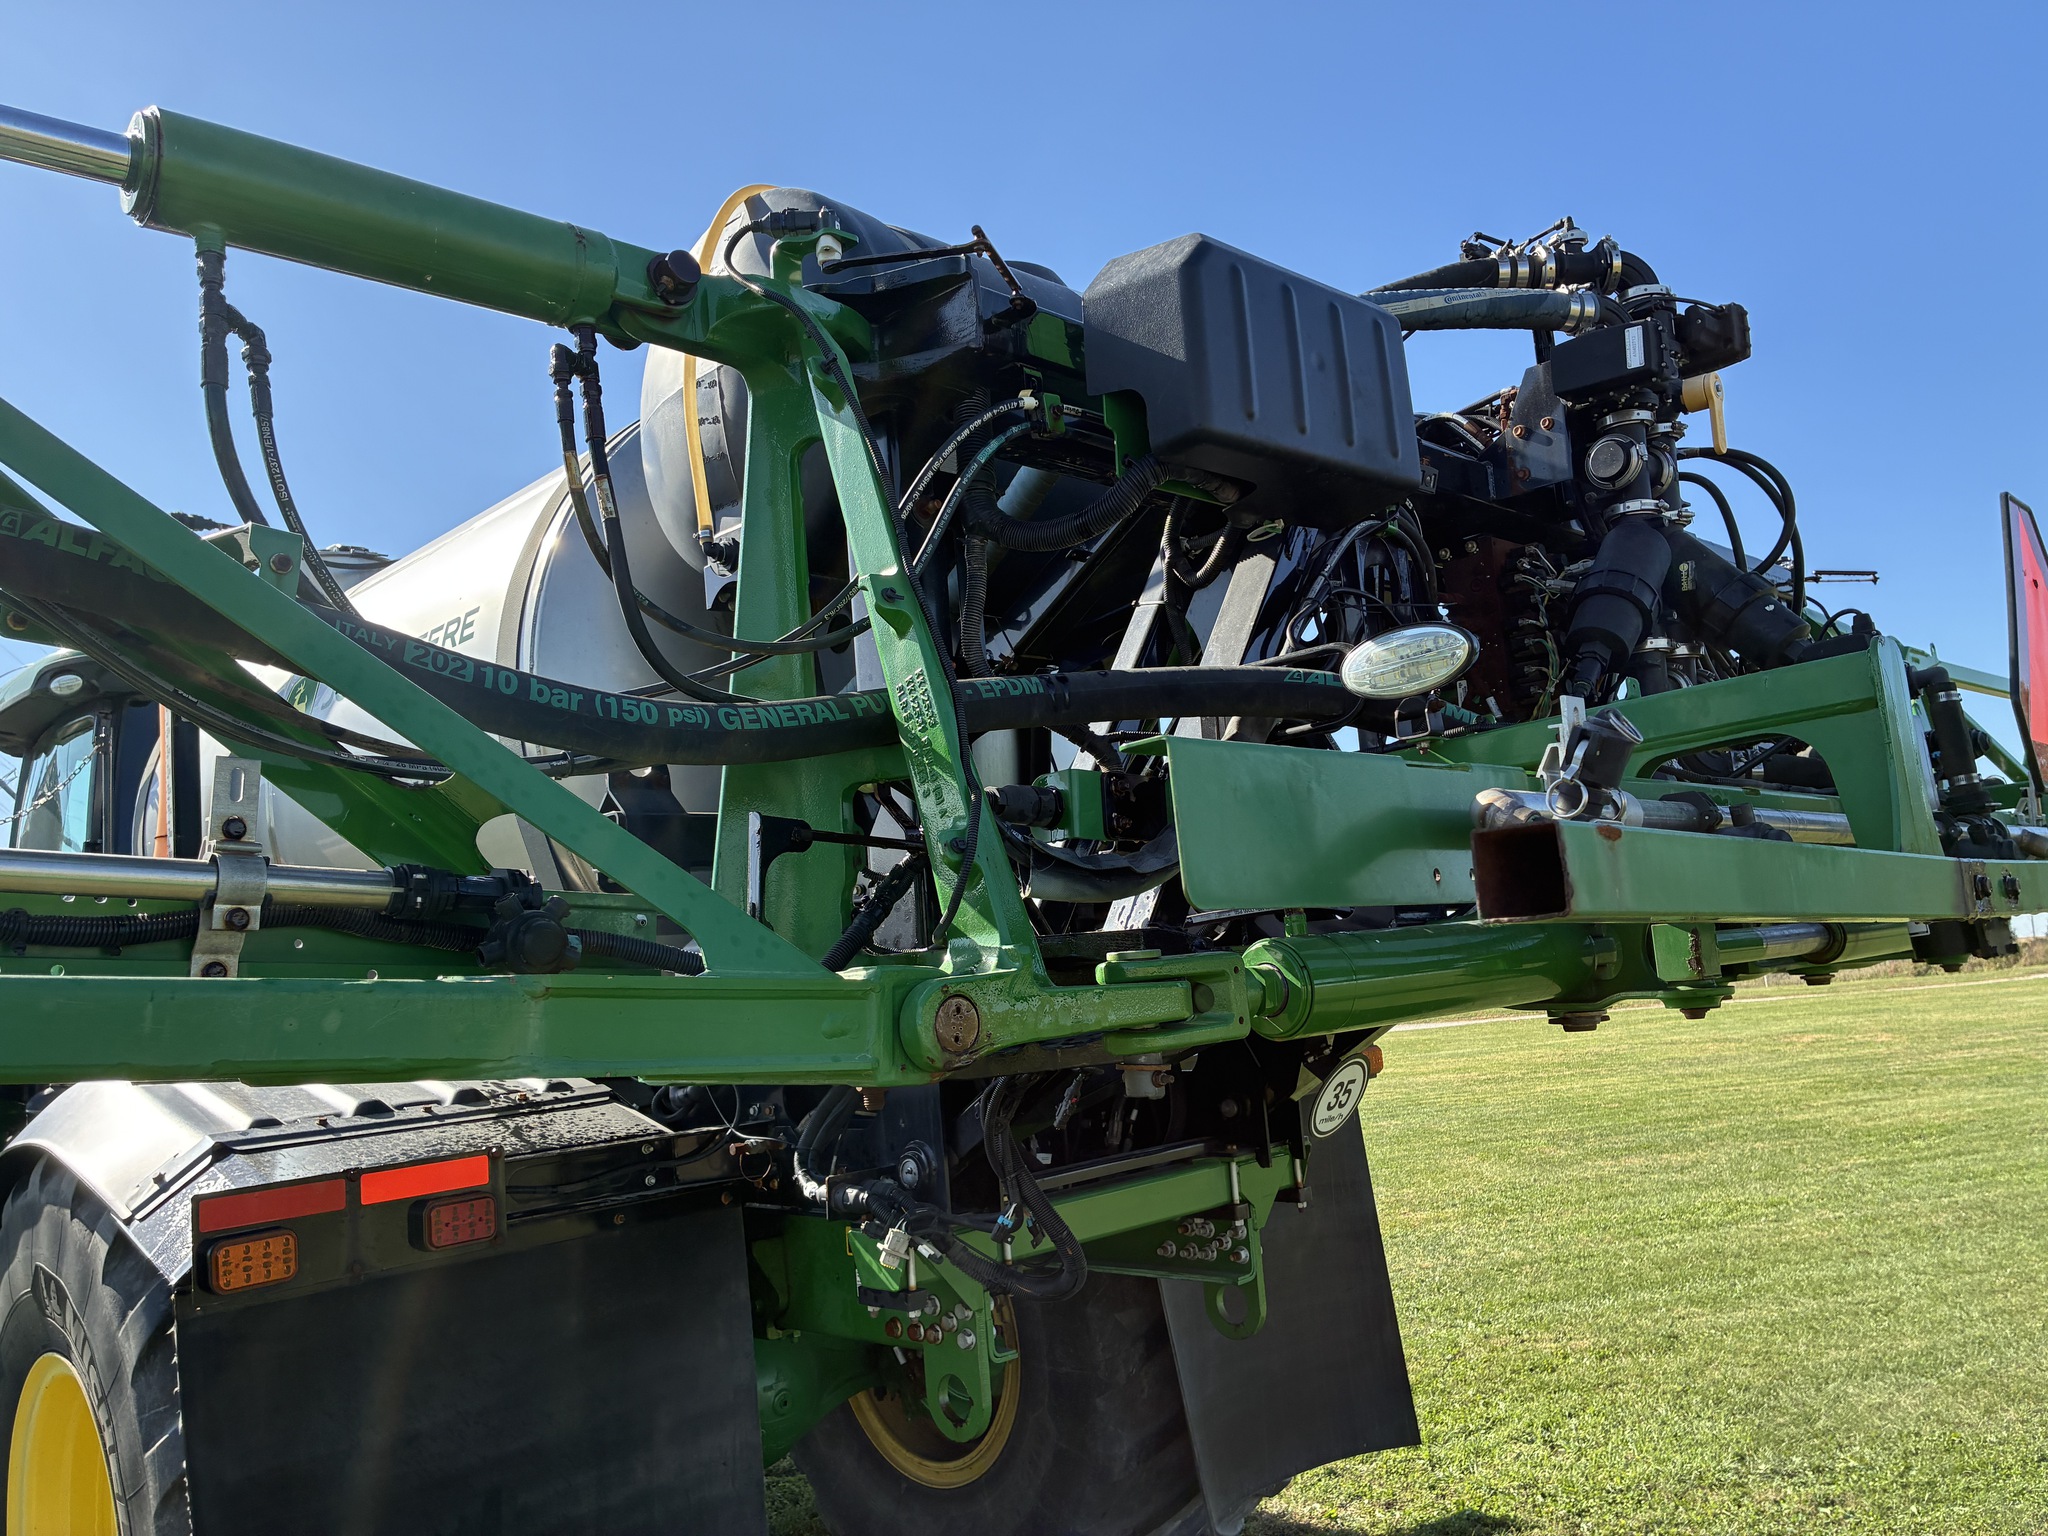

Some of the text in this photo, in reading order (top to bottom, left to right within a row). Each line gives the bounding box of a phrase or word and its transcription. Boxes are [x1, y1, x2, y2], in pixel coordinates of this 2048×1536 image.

[956, 429, 971, 445] MPa
[917, 467, 935, 492] MSHA
[335, 619, 398, 651] ITALY
[409, 643, 469, 681] 202
[480, 665, 519, 695] 10
[529, 677, 584, 712] bar
[594, 694, 659, 725] (150
[667, 705, 710, 730] psi)
[717, 698, 850, 731] GENERAL
[848, 691, 894, 717] PU
[976, 676, 1045, 699] EPDM
[1326, 1078, 1357, 1112] 35
[1318, 1113, 1344, 1125] mile/h
